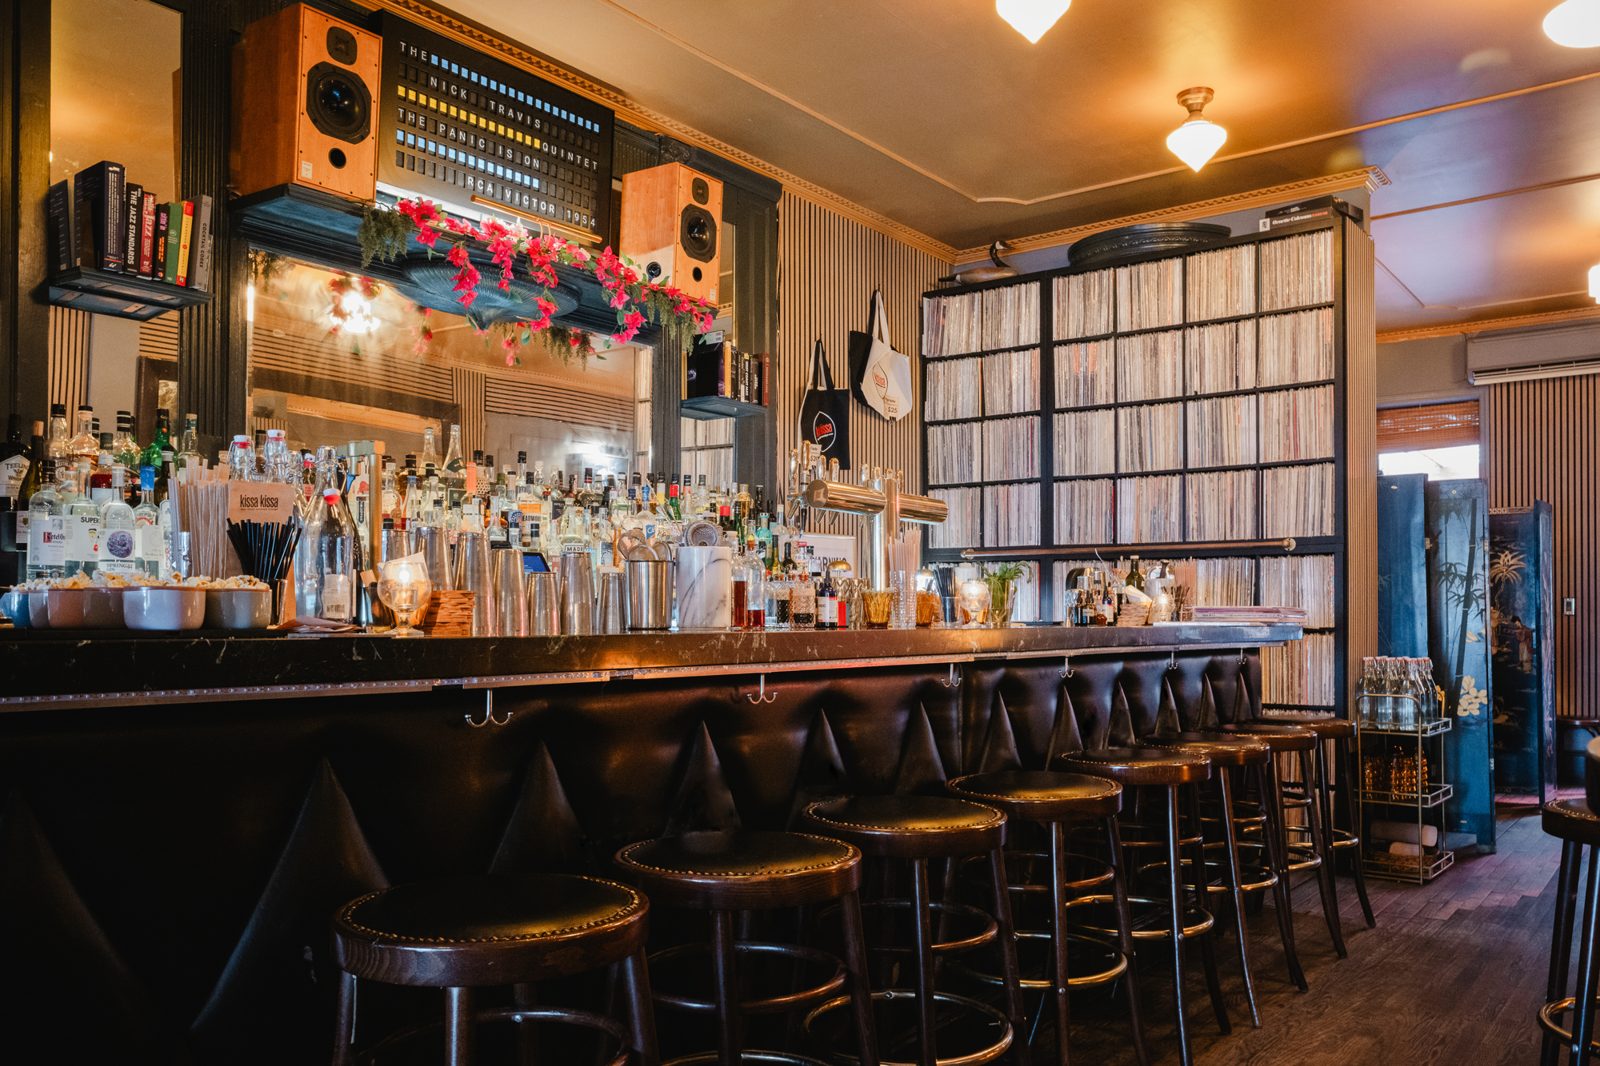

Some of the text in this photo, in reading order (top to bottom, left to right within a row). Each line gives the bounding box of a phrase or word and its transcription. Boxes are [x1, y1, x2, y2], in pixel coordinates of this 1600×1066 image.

[400, 41, 428, 61] THE
[430, 76, 541, 129] NICK TRAVIS
[398, 108, 540, 168] THE PANIC IS ON
[542, 142, 598, 170] QUINTET
[467, 175, 597, 227] RCA VICTOR 1954
[127, 190, 138, 265] THE JAZZ STANDARDS
[240, 494, 278, 507] kissa kissa
